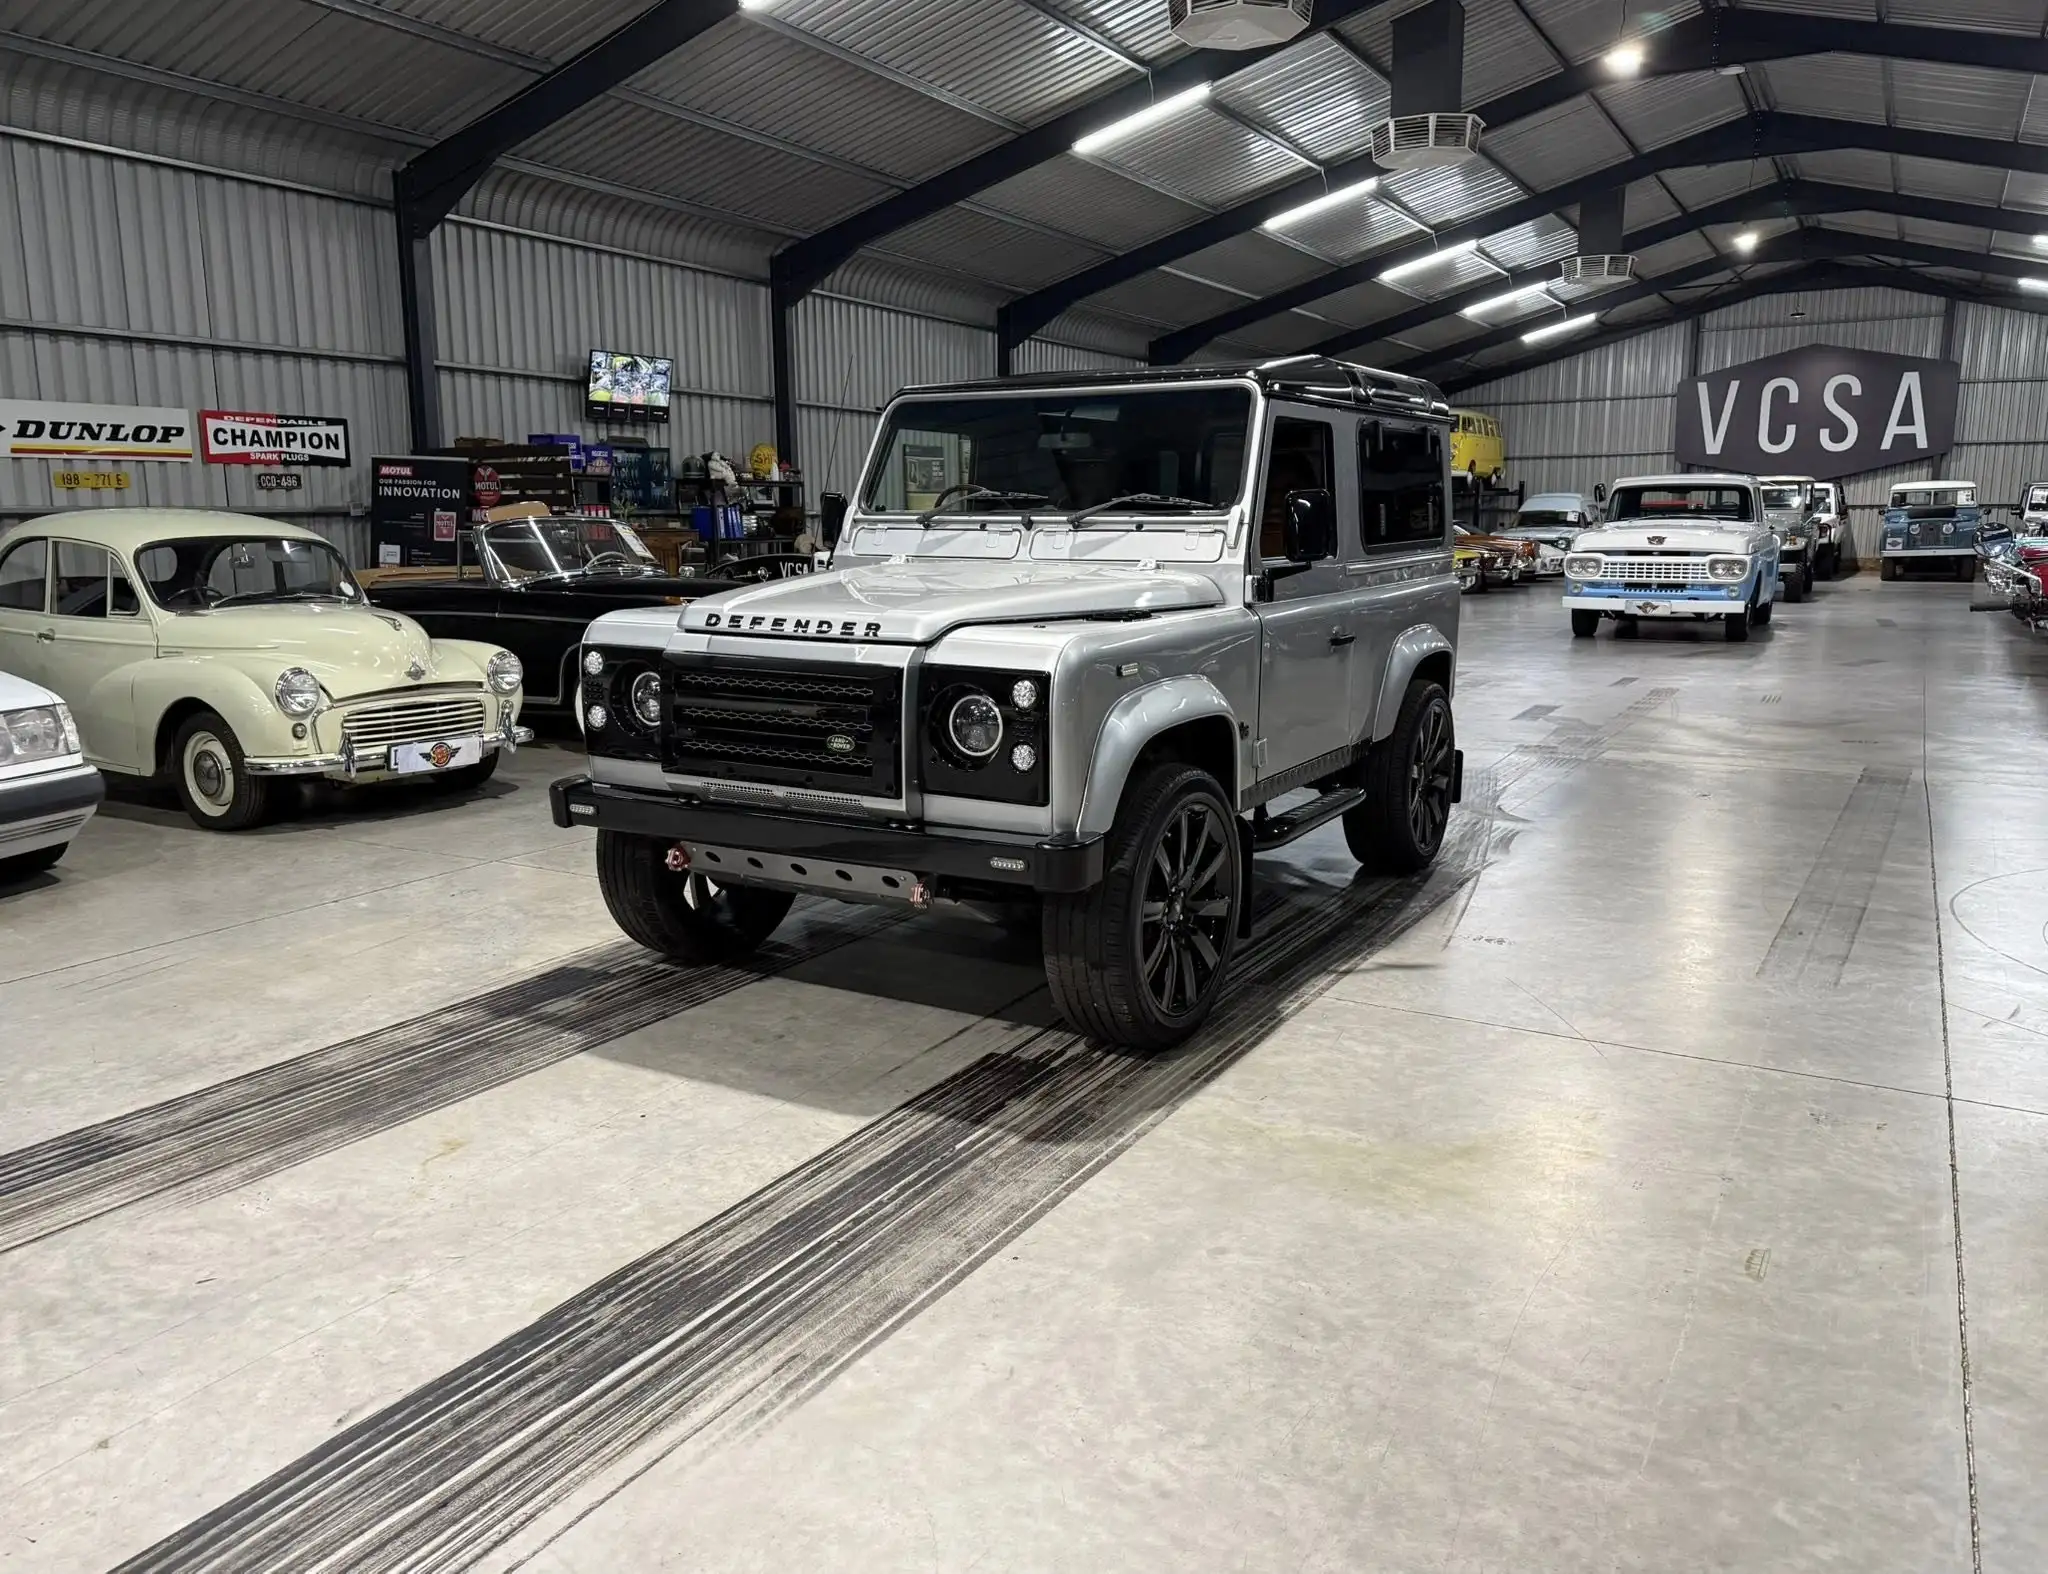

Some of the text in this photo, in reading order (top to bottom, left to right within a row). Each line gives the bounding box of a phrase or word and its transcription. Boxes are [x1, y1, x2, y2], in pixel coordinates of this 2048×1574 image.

[1696, 371, 1929, 456] VCSA
[223, 415, 327, 426] DEPENDABLE
[12, 419, 185, 443] DUNLOP
[212, 427, 340, 450] CHAMPION
[249, 452, 310, 463] SPARK PLUGS
[380, 466, 412, 476] MOTUL
[394, 478, 423, 486] PASSION
[474, 481, 499, 490] MOTUL
[378, 485, 461, 500] INNOVATION
[705, 613, 882, 637] DEFENDER
